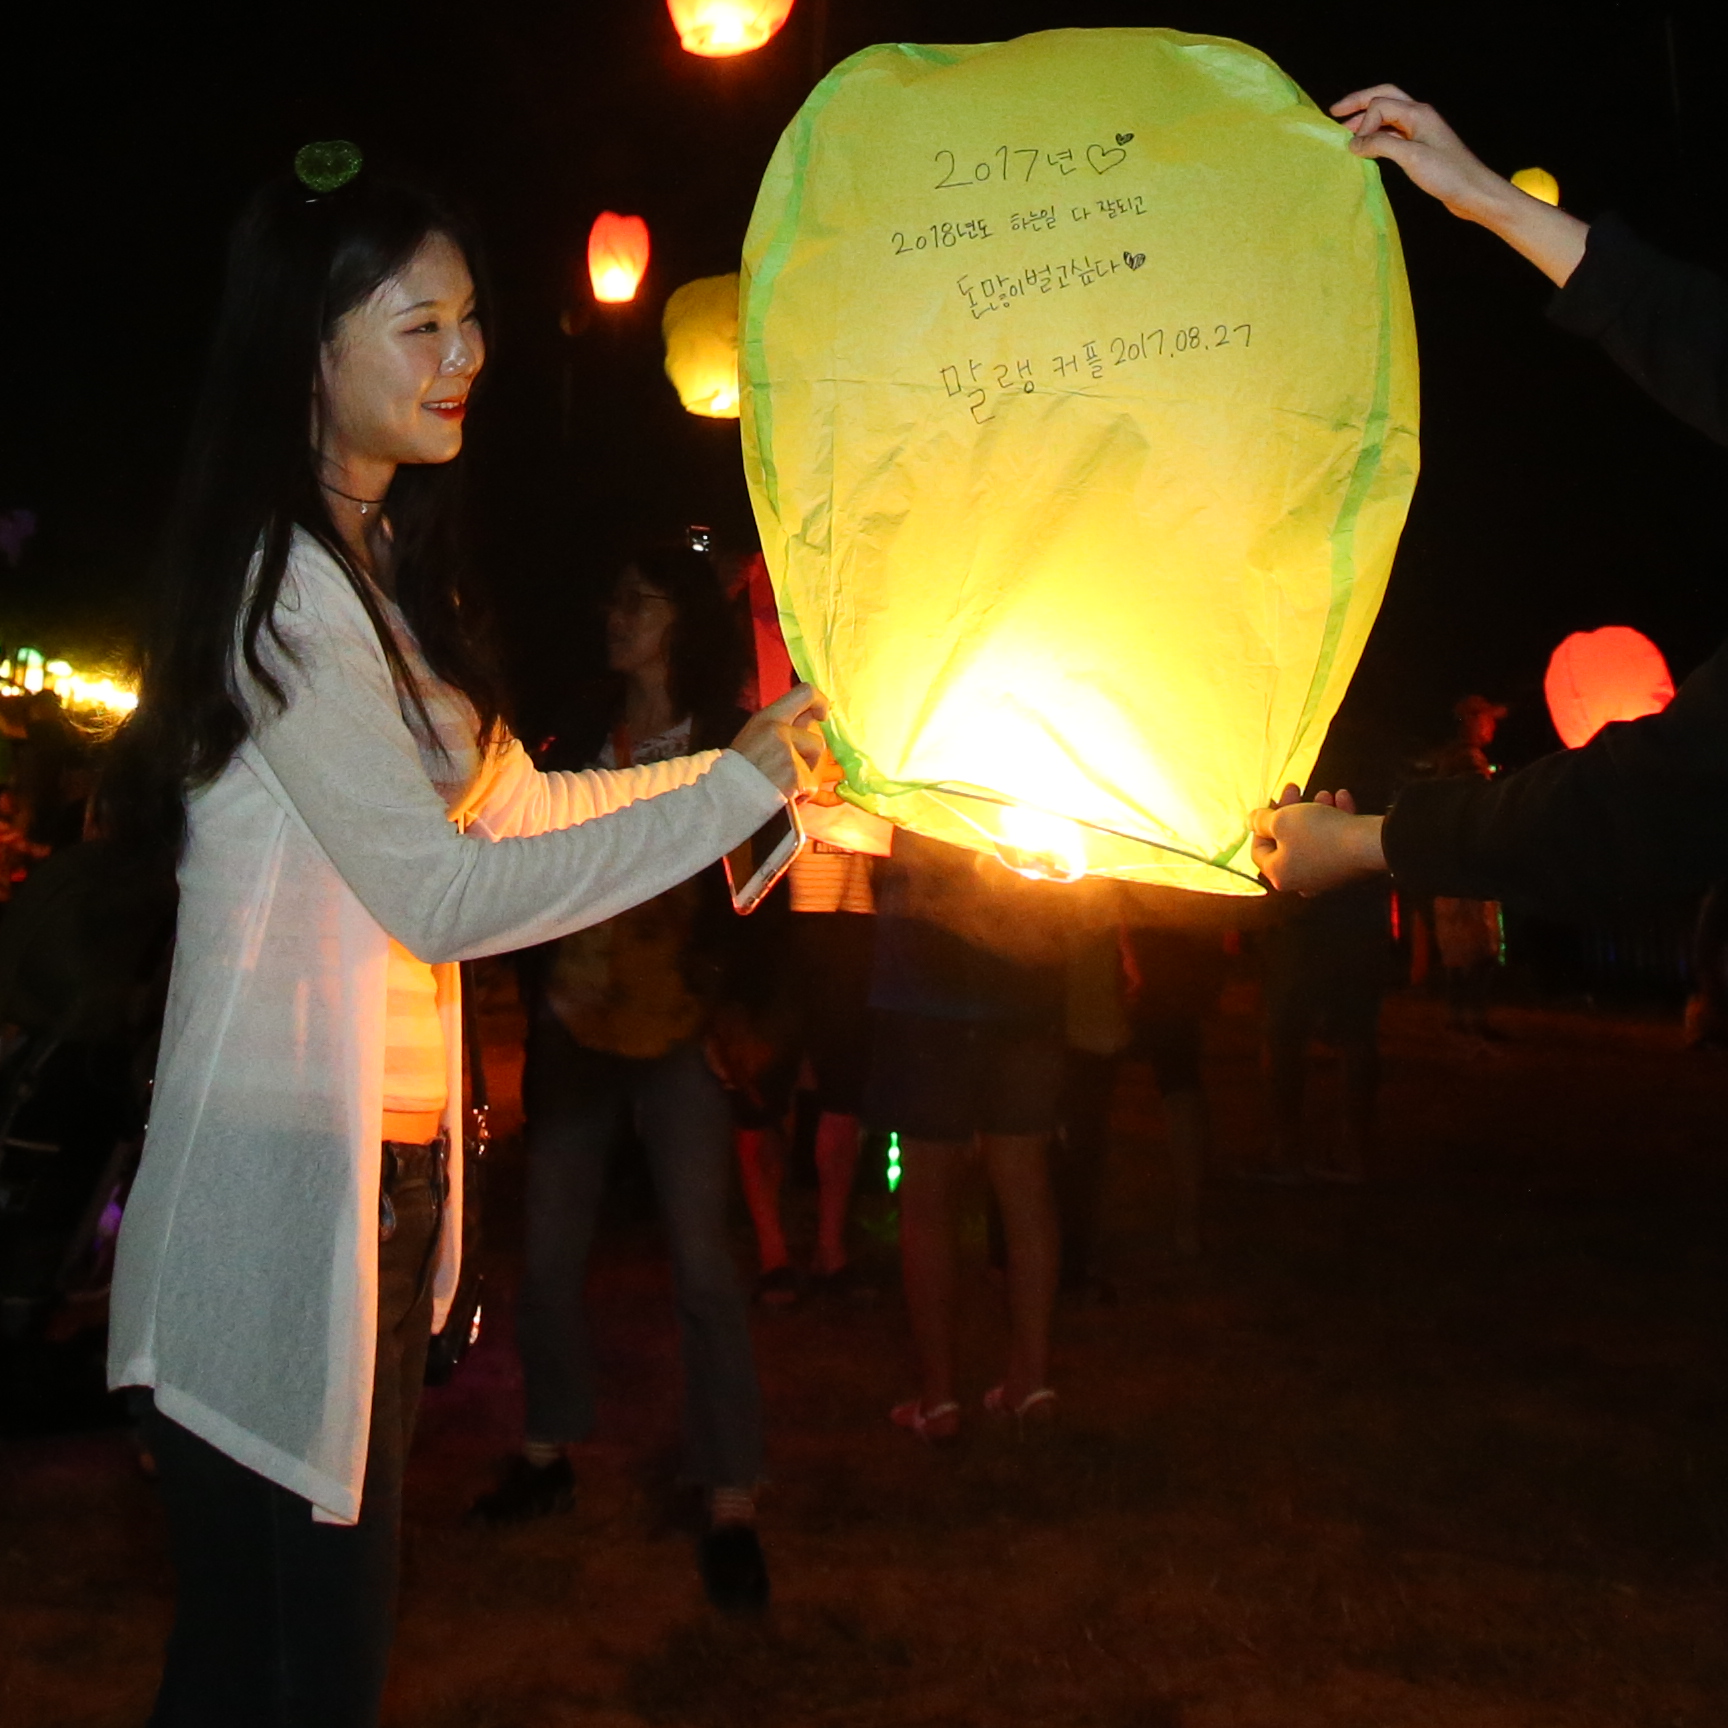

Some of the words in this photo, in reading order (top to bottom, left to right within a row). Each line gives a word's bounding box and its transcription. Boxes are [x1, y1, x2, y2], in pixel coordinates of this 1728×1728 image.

[934, 145, 1076, 189] 2017년
[891, 219, 994, 255] 2018년도
[1071, 206, 1092, 221] 다
[1096, 195, 1148, 220] 잘되고
[1052, 340, 1103, 380] 커플
[1109, 324, 1252, 367] 2017.08.27
